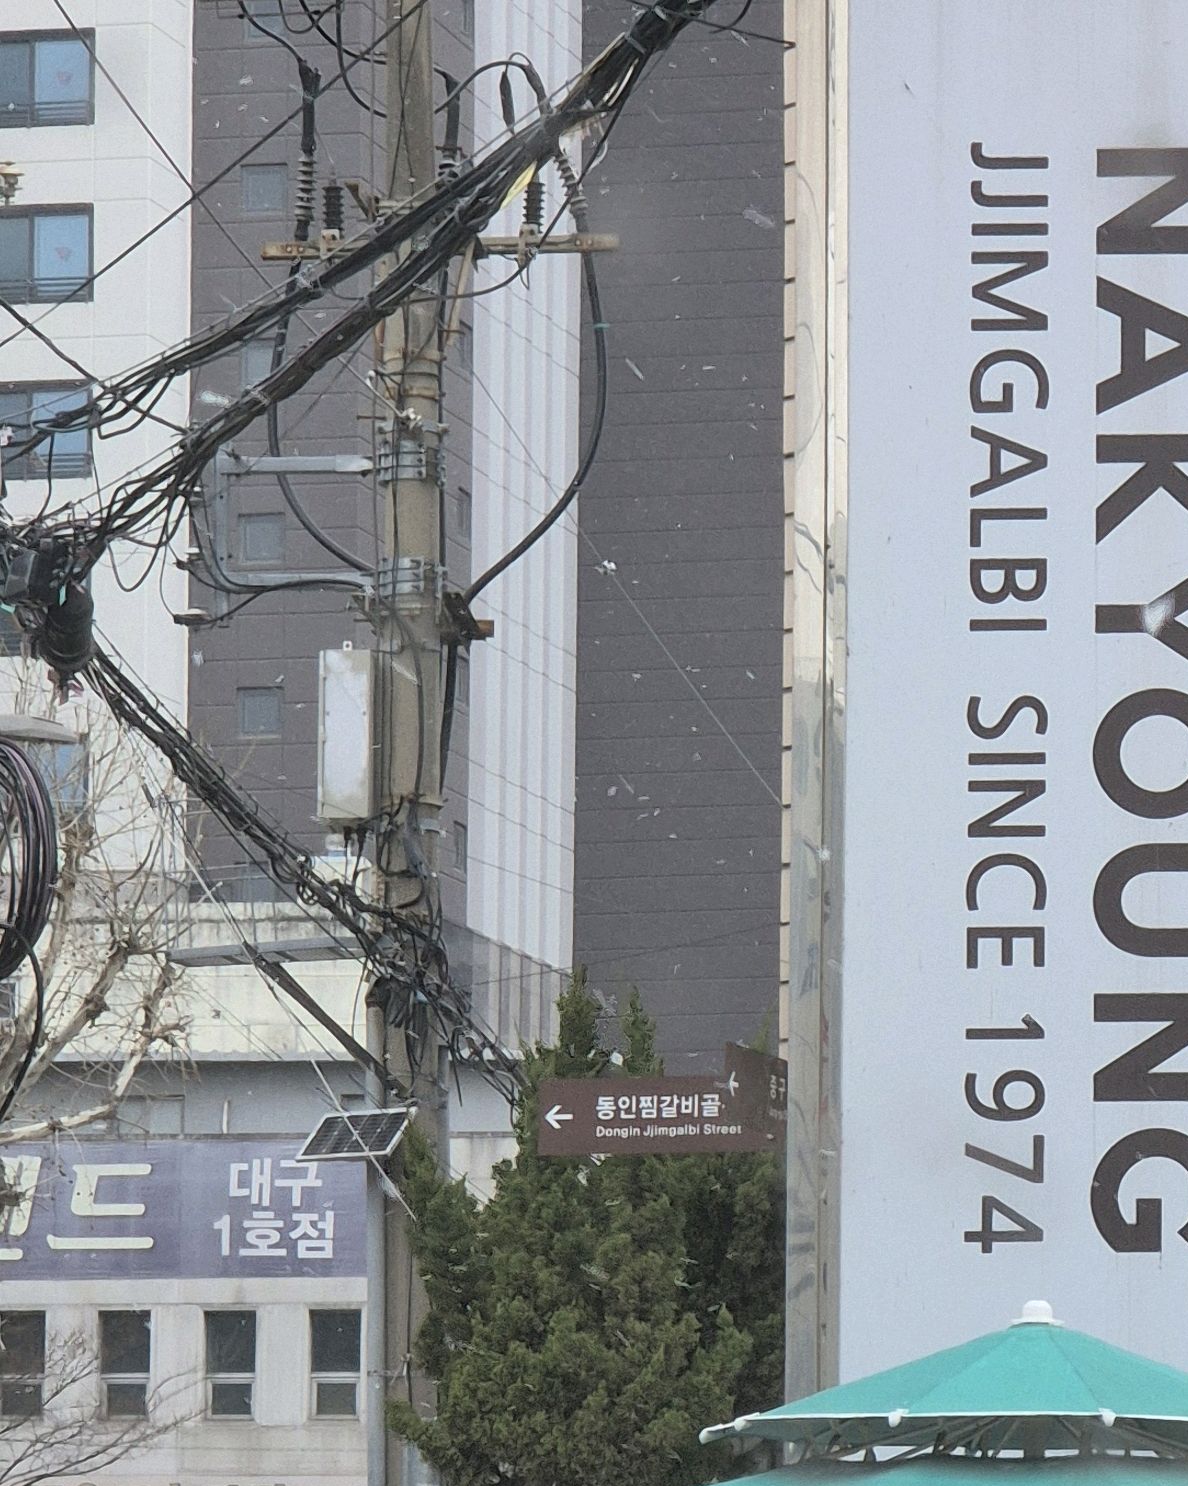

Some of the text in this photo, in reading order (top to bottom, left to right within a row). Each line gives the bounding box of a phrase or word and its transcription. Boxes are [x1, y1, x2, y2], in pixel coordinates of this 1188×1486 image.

[963, 142, 1050, 1254] JJIMGALBI SINCE 1974
[595, 1092, 722, 1121] 동인찜갈비골
[595, 1123, 743, 1140] Dongin Jjimgalbi Street
[228, 1157, 323, 1208] 대구
[212, 1210, 336, 1260] 1호점
